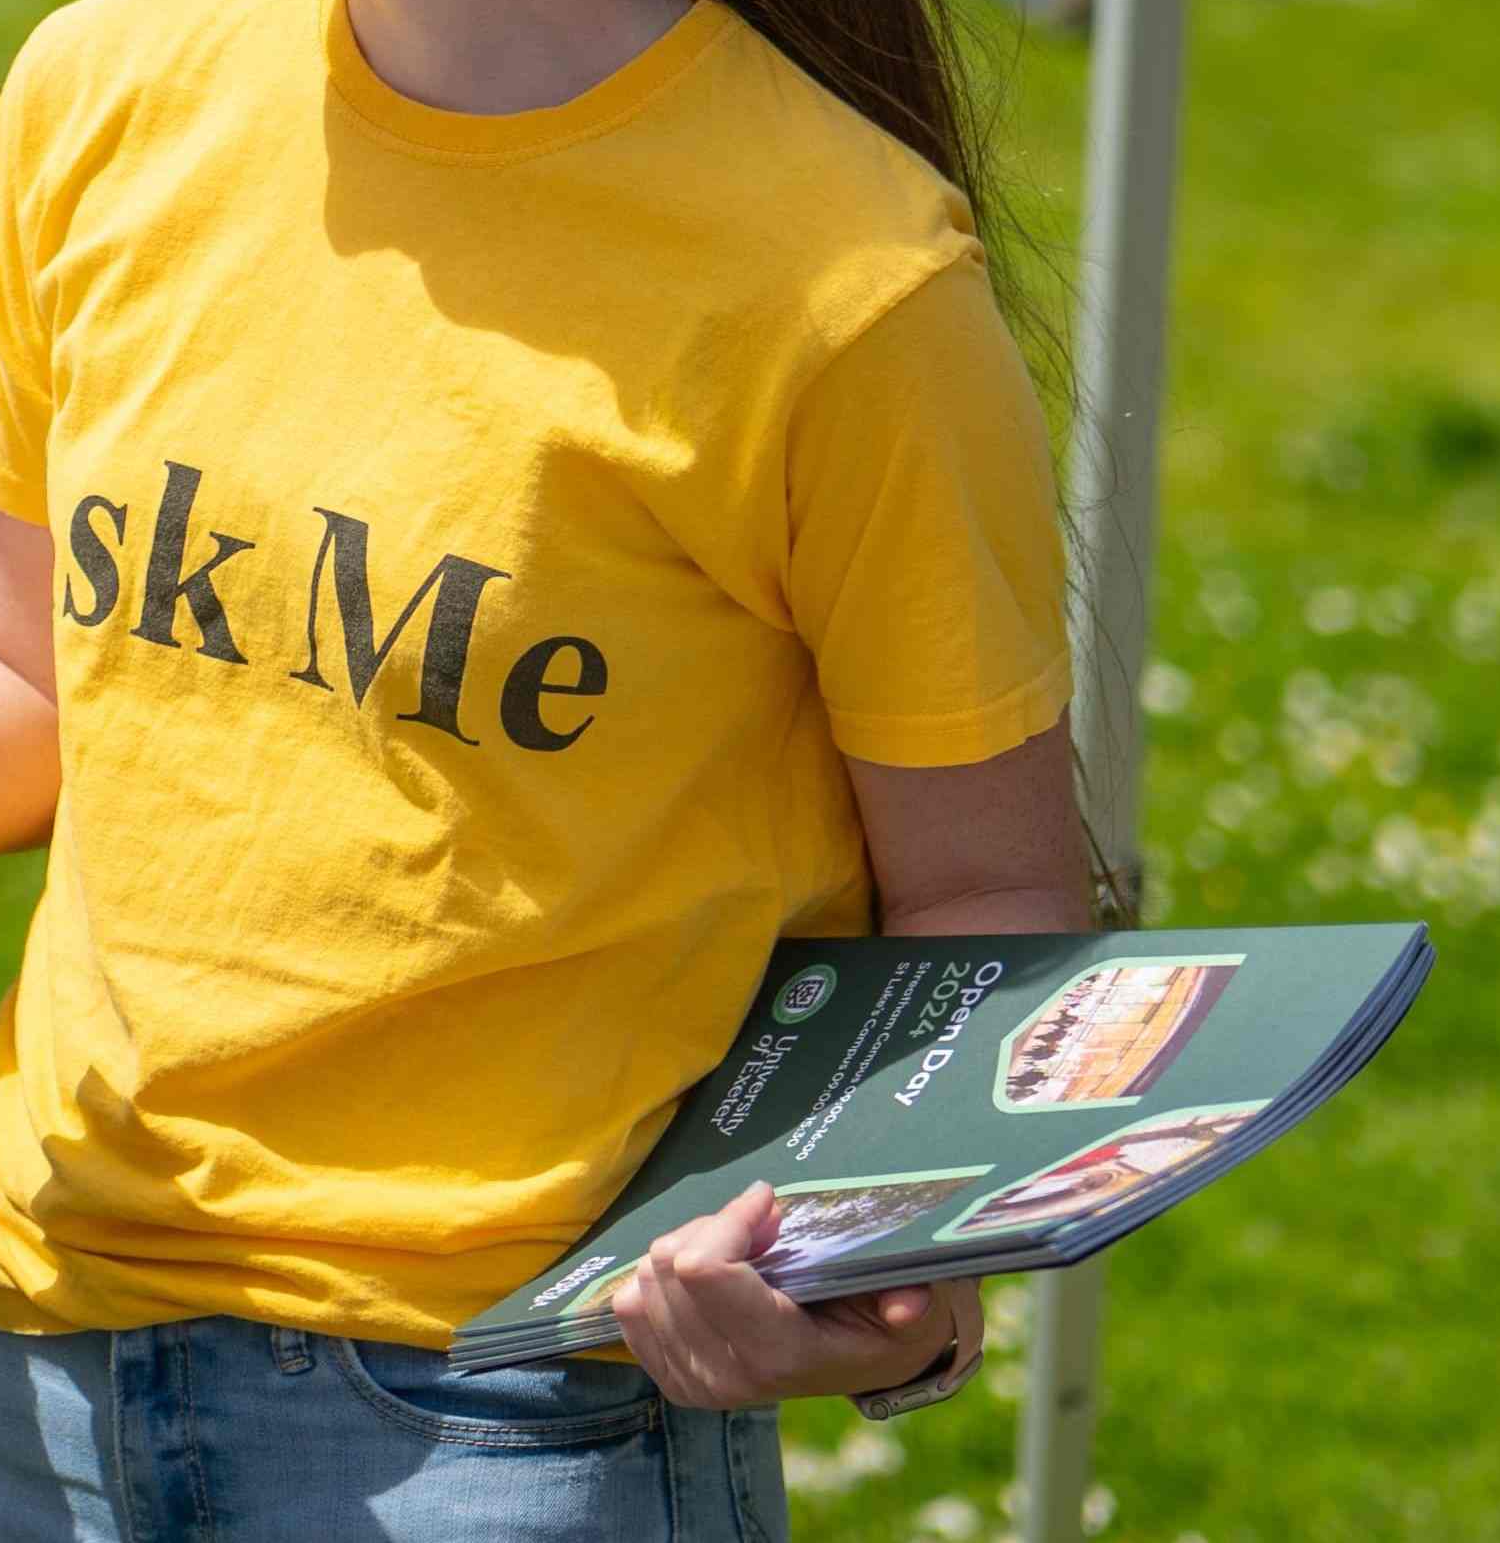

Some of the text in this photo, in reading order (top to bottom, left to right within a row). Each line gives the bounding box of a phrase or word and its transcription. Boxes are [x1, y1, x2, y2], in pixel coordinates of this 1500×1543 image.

[62, 459, 609, 753] sk Me
[882, 961, 933, 1031] Streatham
[895, 961, 911, 975] St
[908, 961, 971, 1039] 2024
[837, 1017, 878, 1071] Campus
[850, 1031, 891, 1083] Campus
[894, 960, 1004, 1107] Open Day
[710, 1034, 774, 1127] of Exeter
[719, 1034, 800, 1137] University
